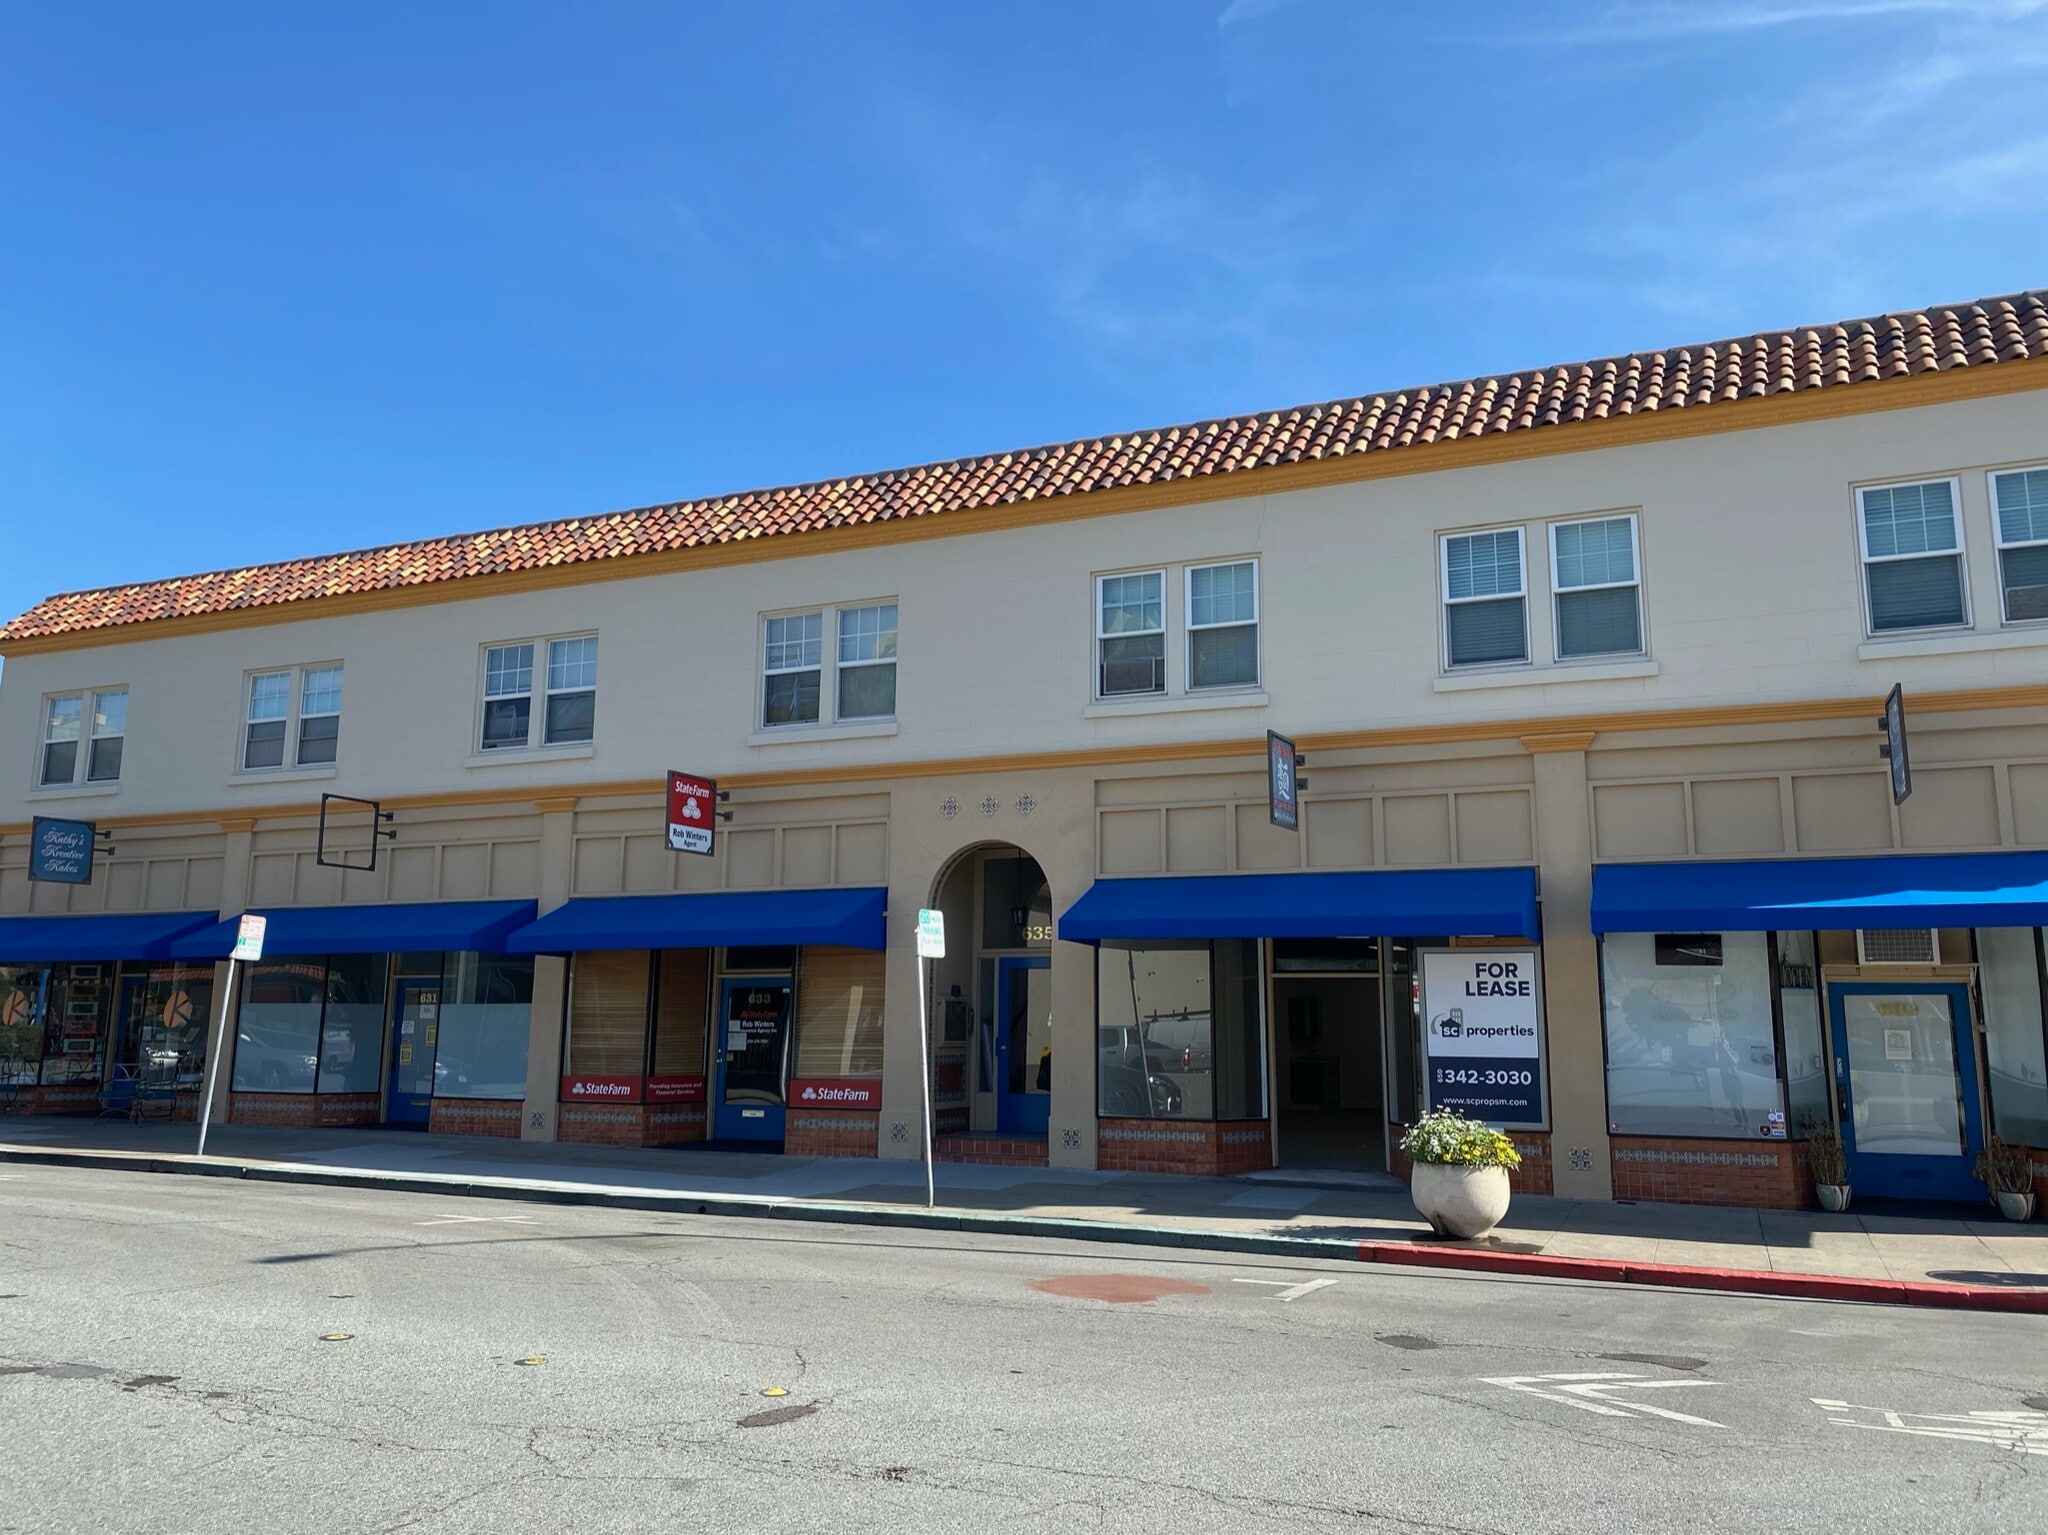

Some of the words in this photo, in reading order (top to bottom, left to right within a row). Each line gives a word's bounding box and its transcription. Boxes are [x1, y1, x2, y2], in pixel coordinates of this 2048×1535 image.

[43, 831, 84, 848] Kathy's
[673, 828, 684, 838] Rob
[686, 831, 708, 842] Winters
[684, 840, 697, 848] Agent
[41, 845, 84, 859] Kreative
[43, 859, 79, 873] Kakes
[1023, 926, 1052, 940] 635
[1475, 963, 1518, 978] FOR
[1465, 981, 1530, 996] LEASE
[420, 993, 437, 1003] 631
[749, 993, 770, 1004] 633
[1443, 1027, 1458, 1036] SC
[1466, 1025, 1534, 1038] properties
[1445, 1070, 1532, 1085] 342-3030
[1443, 1098, 1527, 1106] www.scpropsm.com
